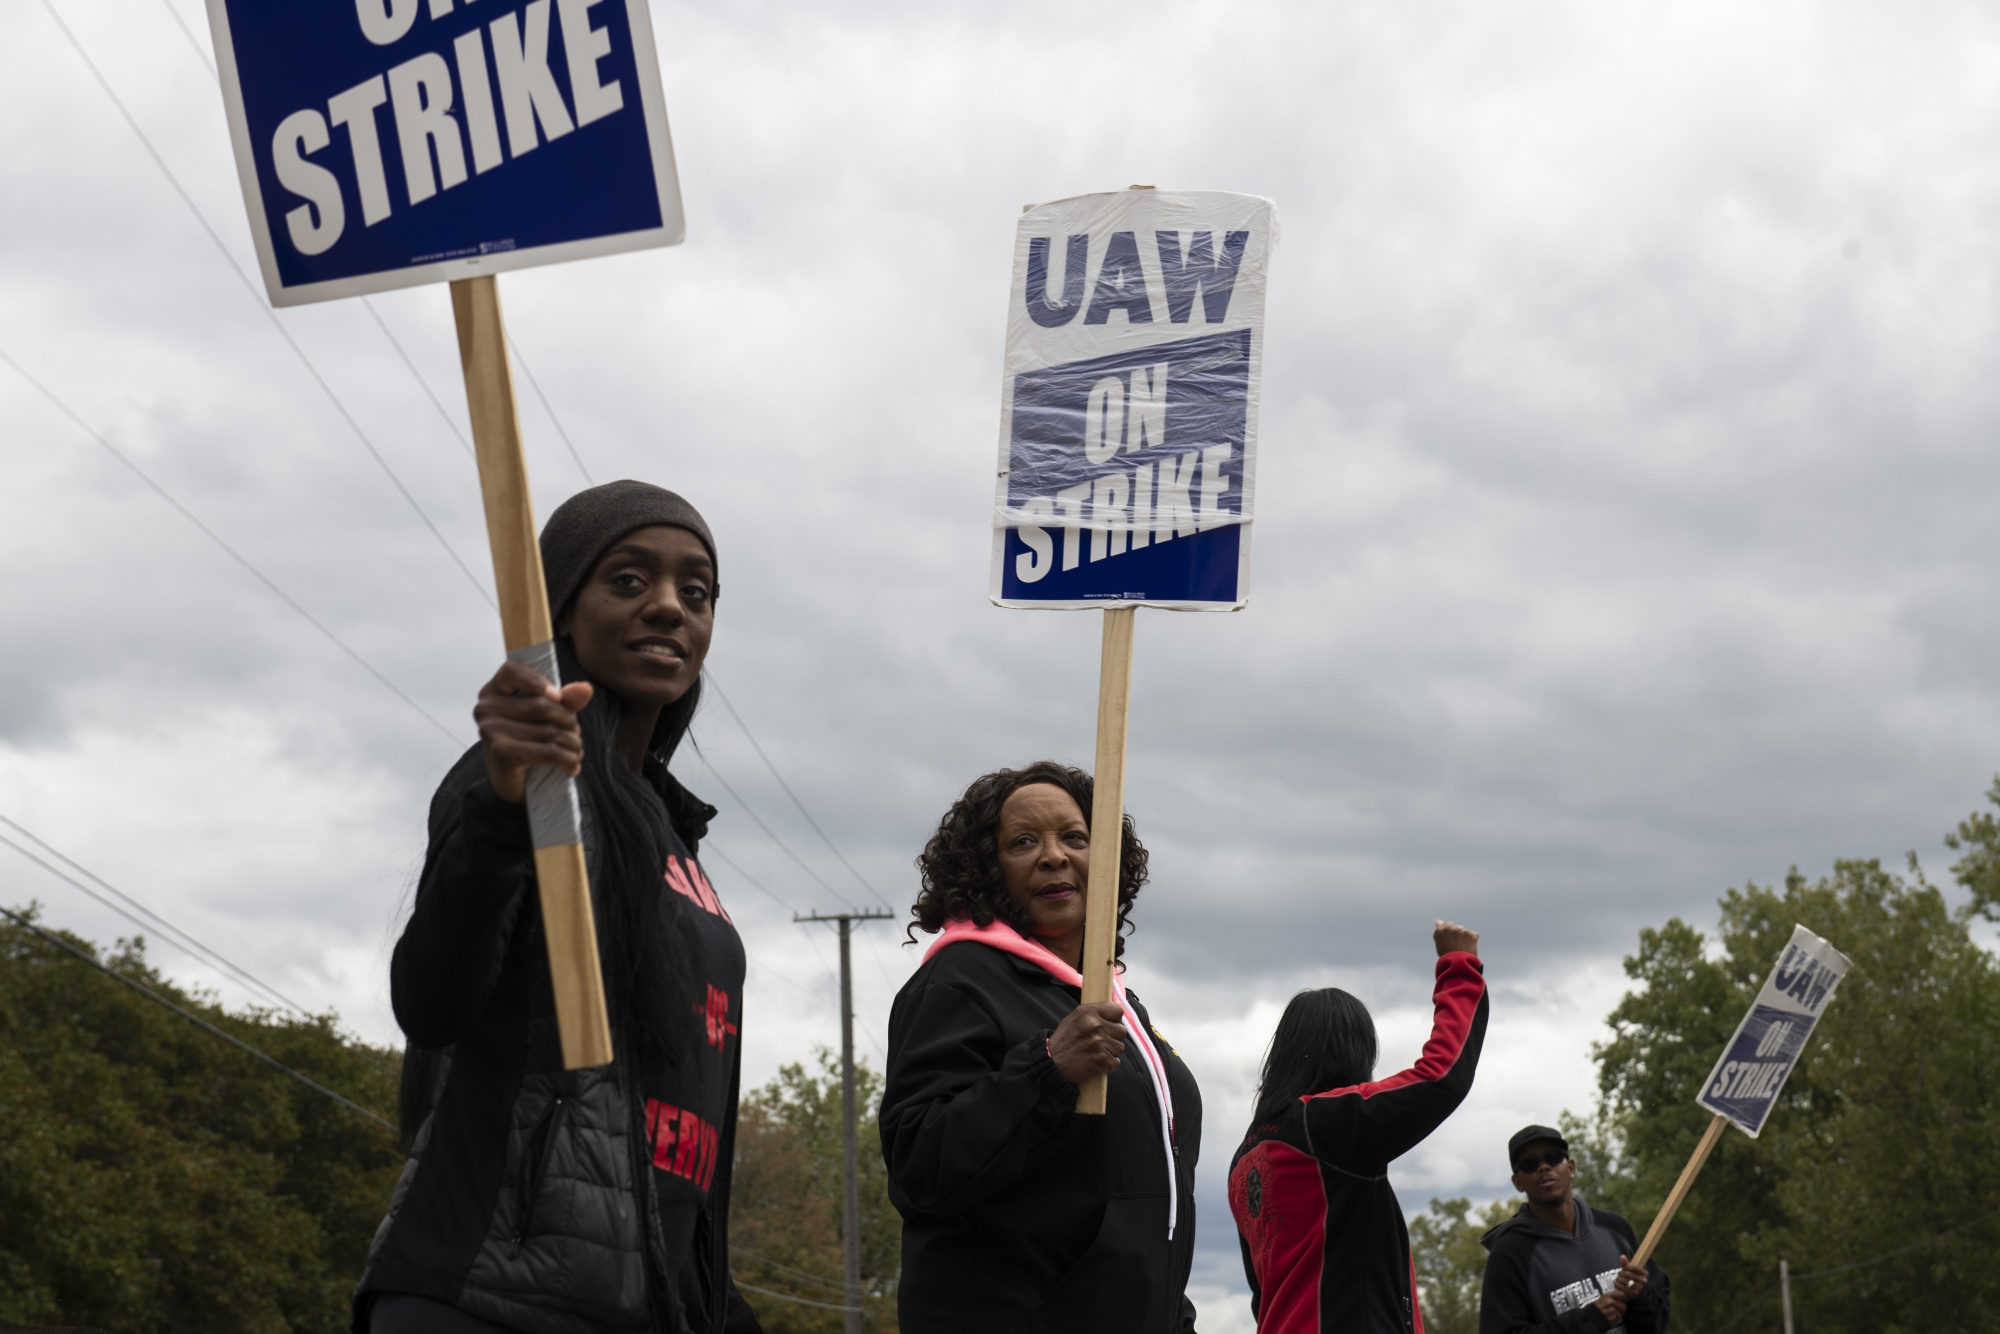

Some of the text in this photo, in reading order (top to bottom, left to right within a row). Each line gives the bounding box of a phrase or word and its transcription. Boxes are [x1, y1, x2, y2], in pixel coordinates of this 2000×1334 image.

[272, 0, 624, 256] STRIKE
[1026, 231, 1249, 328] UAW
[1085, 362, 1168, 465] ON
[1015, 443, 1232, 584] STRIKE
[1775, 945, 1837, 1011] UAW
[1710, 1060, 1788, 1098] STRIKE
[1755, 1020, 1793, 1057] ON
